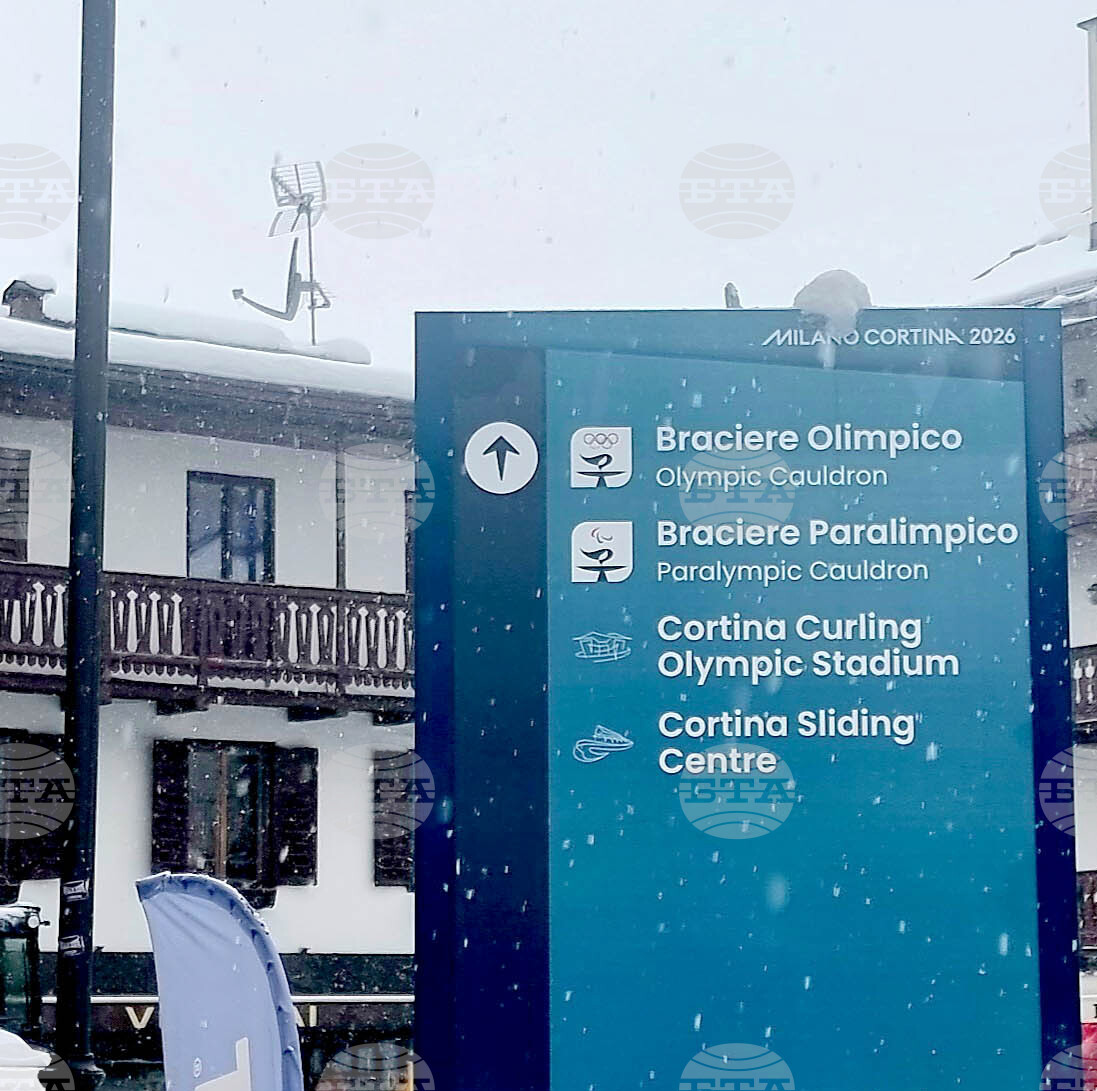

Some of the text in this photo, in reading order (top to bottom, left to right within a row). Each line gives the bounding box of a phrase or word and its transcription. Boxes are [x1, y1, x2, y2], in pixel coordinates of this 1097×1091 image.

[864, 327, 964, 346] CORTINA
[969, 327, 1016, 346] 2026
[656, 423, 963, 459] Braciere Olimpico
[656, 464, 888, 494] Olympic Cauldron
[656, 514, 1019, 552] Braciere Paralimpico
[656, 558, 930, 588] Paralympic Cauldron
[657, 612, 923, 648] Cortina Curling
[657, 648, 960, 686] Olympic Stadium
[657, 708, 916, 745] Cortina Sliding
[657, 746, 778, 776] Centre
